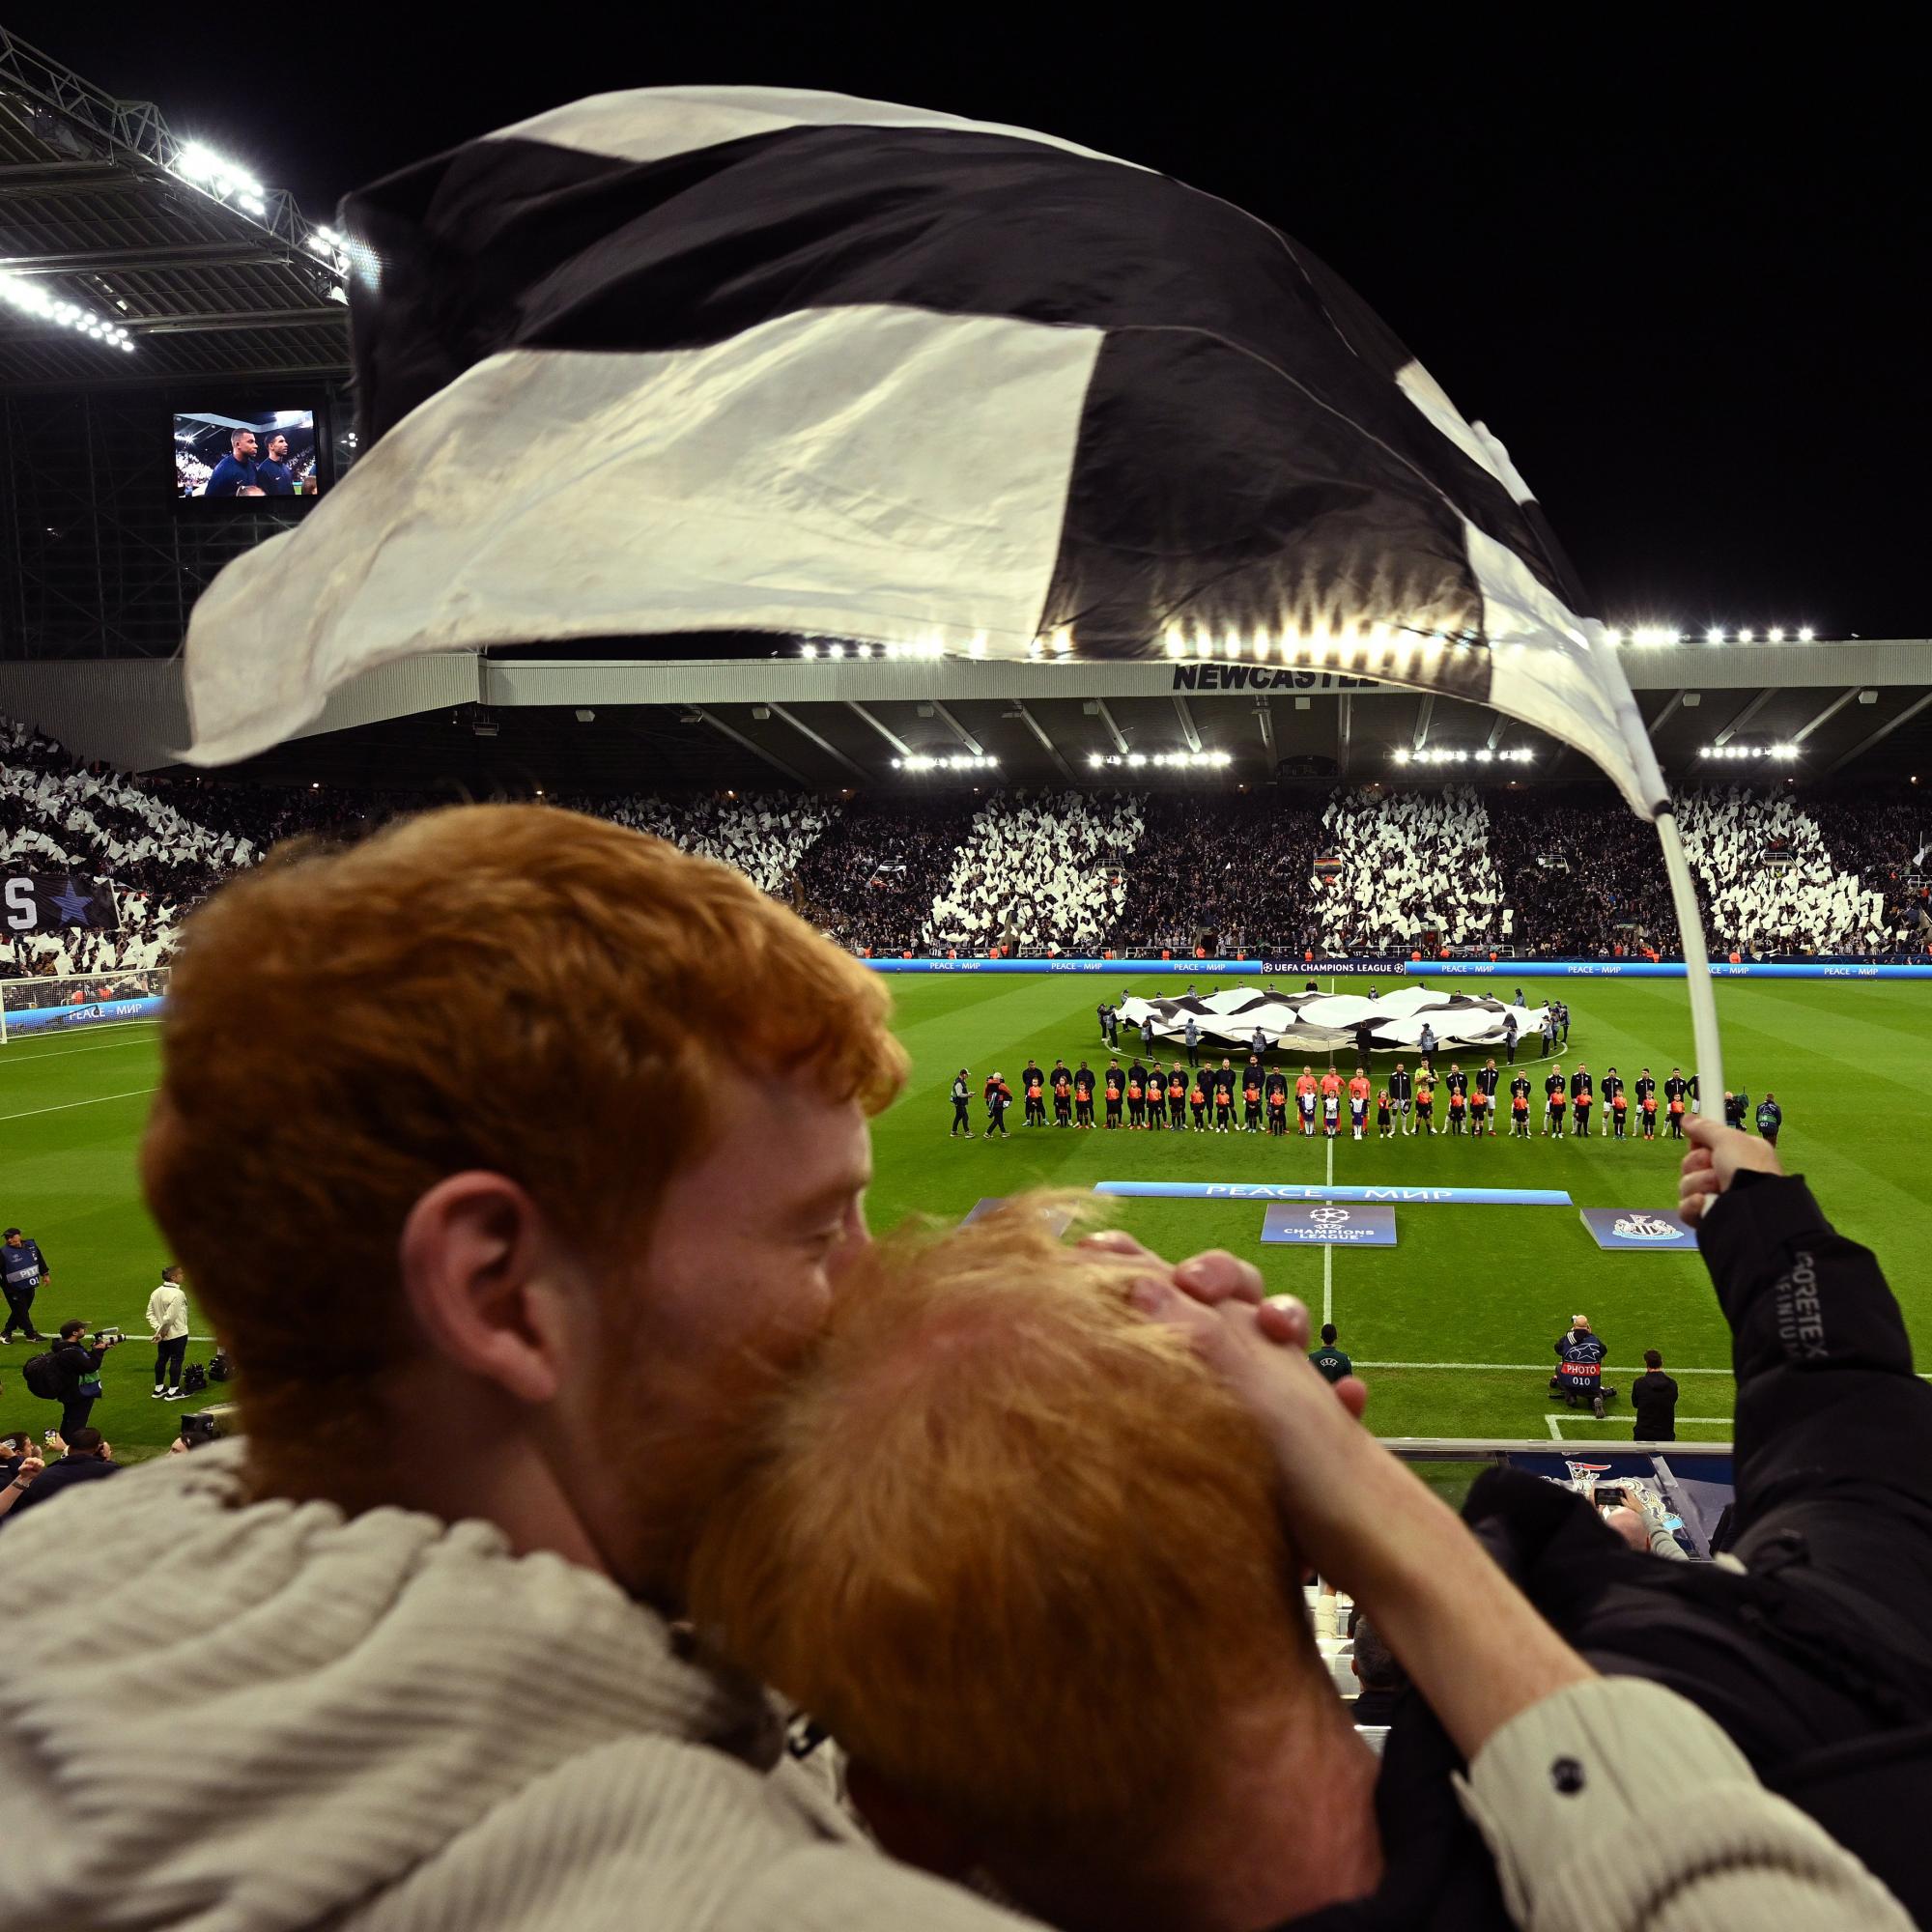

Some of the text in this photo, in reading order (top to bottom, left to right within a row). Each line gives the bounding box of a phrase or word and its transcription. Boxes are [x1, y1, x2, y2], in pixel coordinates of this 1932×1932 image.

[5, 877, 38, 930] S
[69, 1007, 106, 1020] PEACE
[1206, 1185, 1323, 1197] PEACE
[1567, 1364, 1597, 1375] PHOTO
[1572, 1376, 1591, 1386] 010
